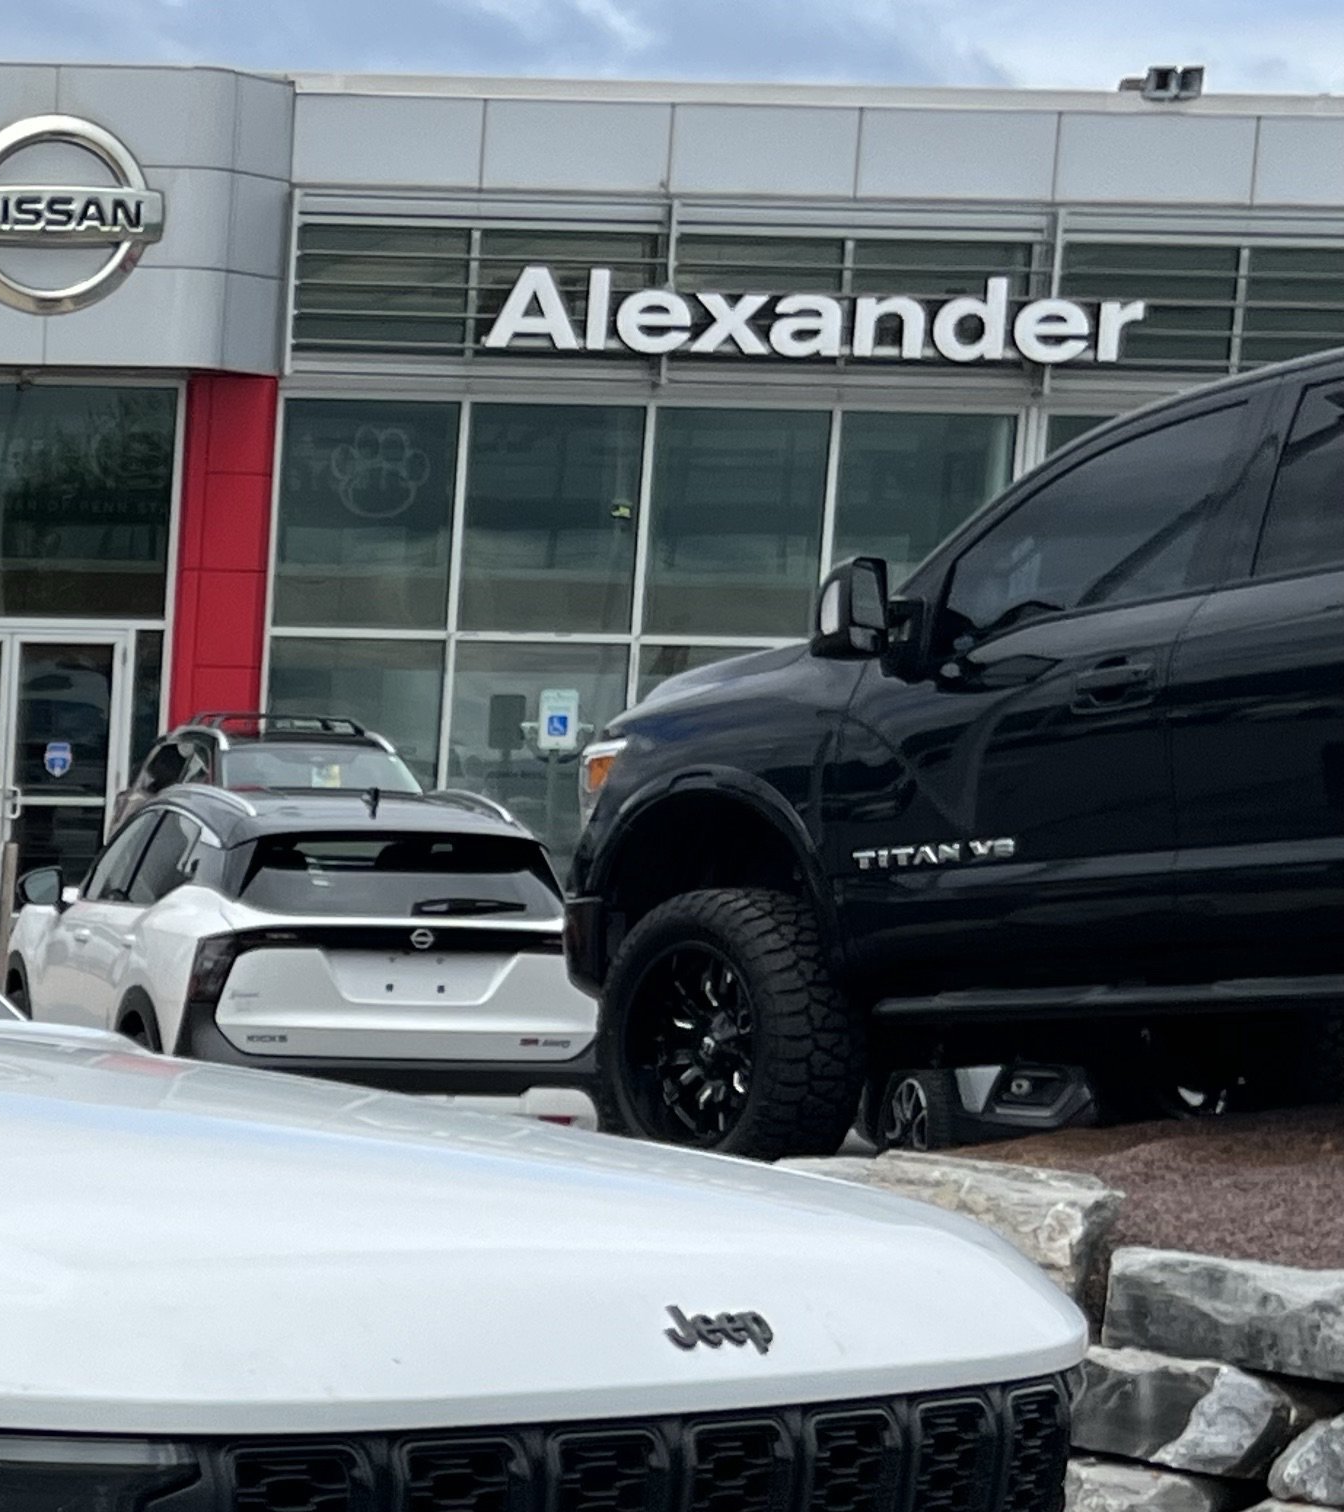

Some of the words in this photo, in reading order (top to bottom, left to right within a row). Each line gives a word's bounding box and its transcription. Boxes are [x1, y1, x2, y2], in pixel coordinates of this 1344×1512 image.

[484, 265, 1145, 363] Alexander
[852, 842, 960, 870] TITAN
[664, 1304, 774, 1355] Jeep
